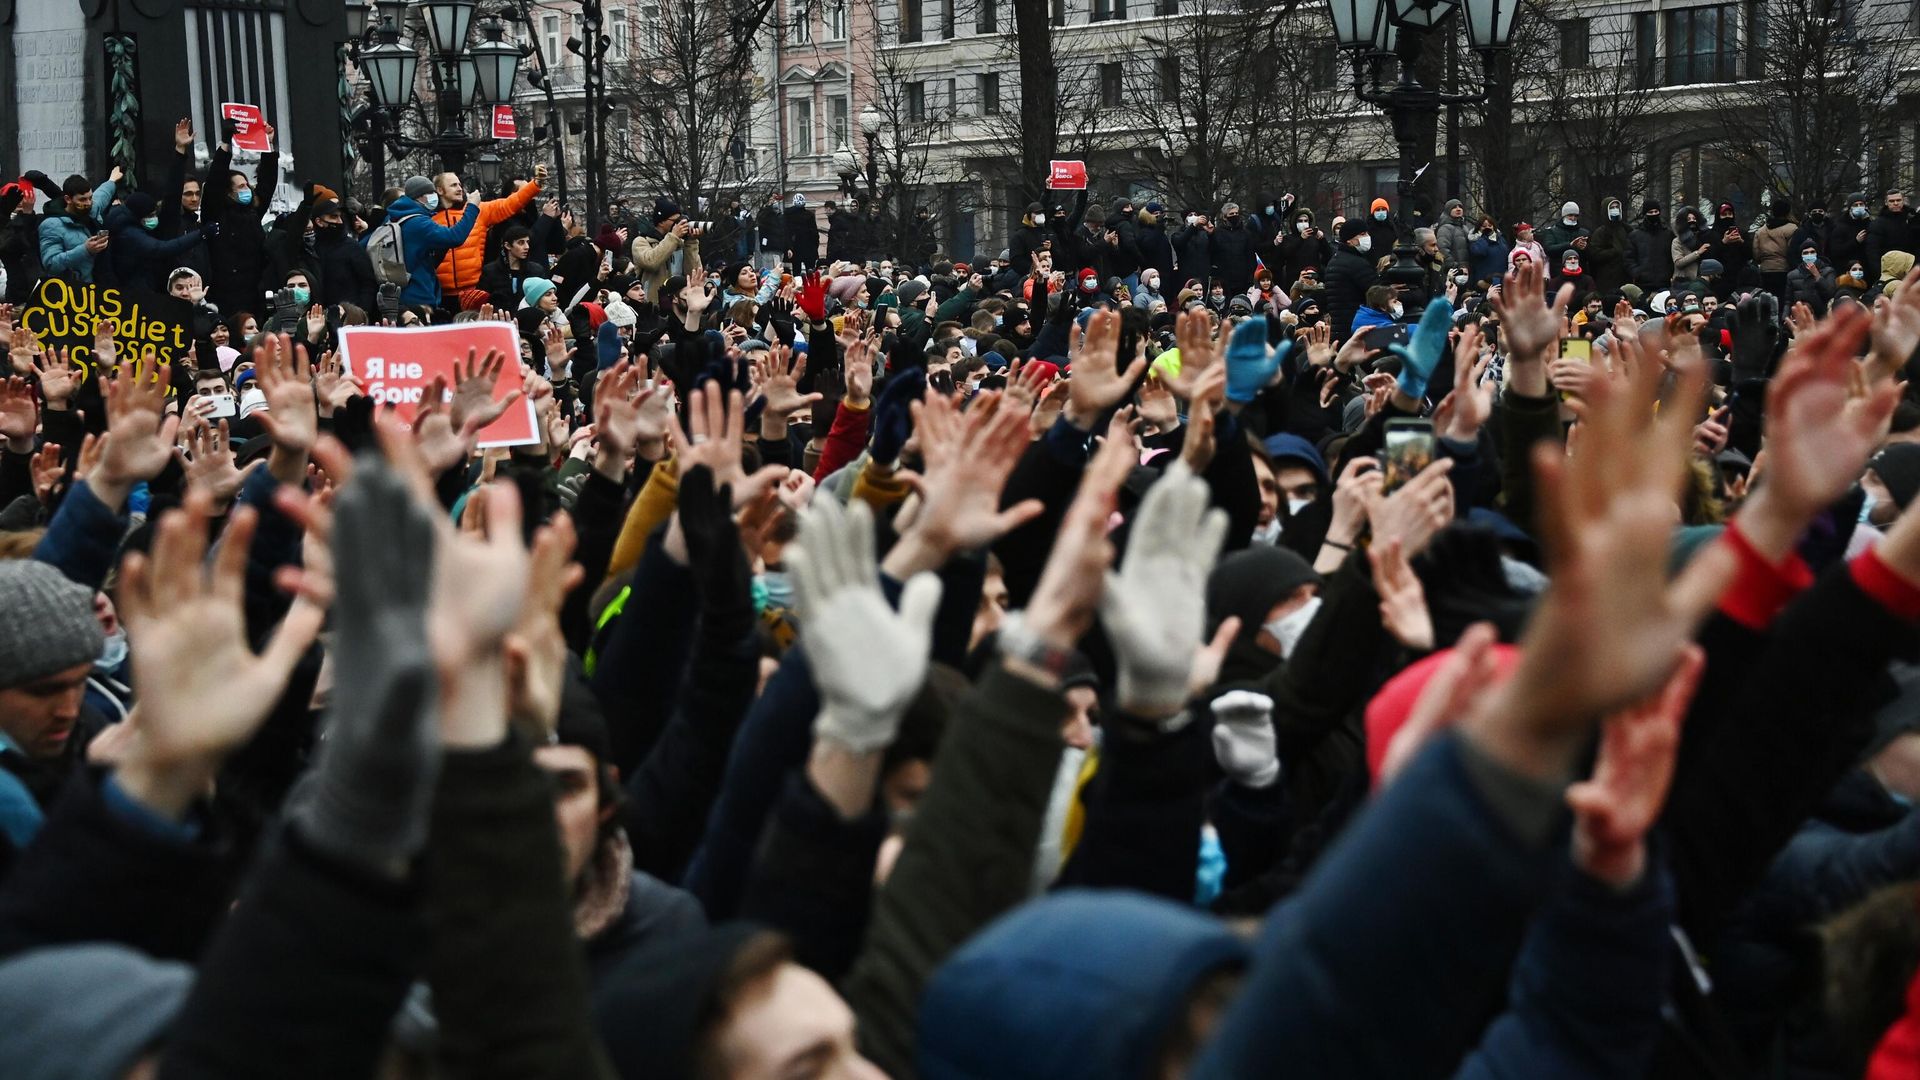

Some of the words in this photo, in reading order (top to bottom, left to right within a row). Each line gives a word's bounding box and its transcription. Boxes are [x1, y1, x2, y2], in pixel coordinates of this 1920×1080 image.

[364, 357, 385, 379] Я
[389, 362, 423, 379] не
[368, 381, 453, 405] боюь
